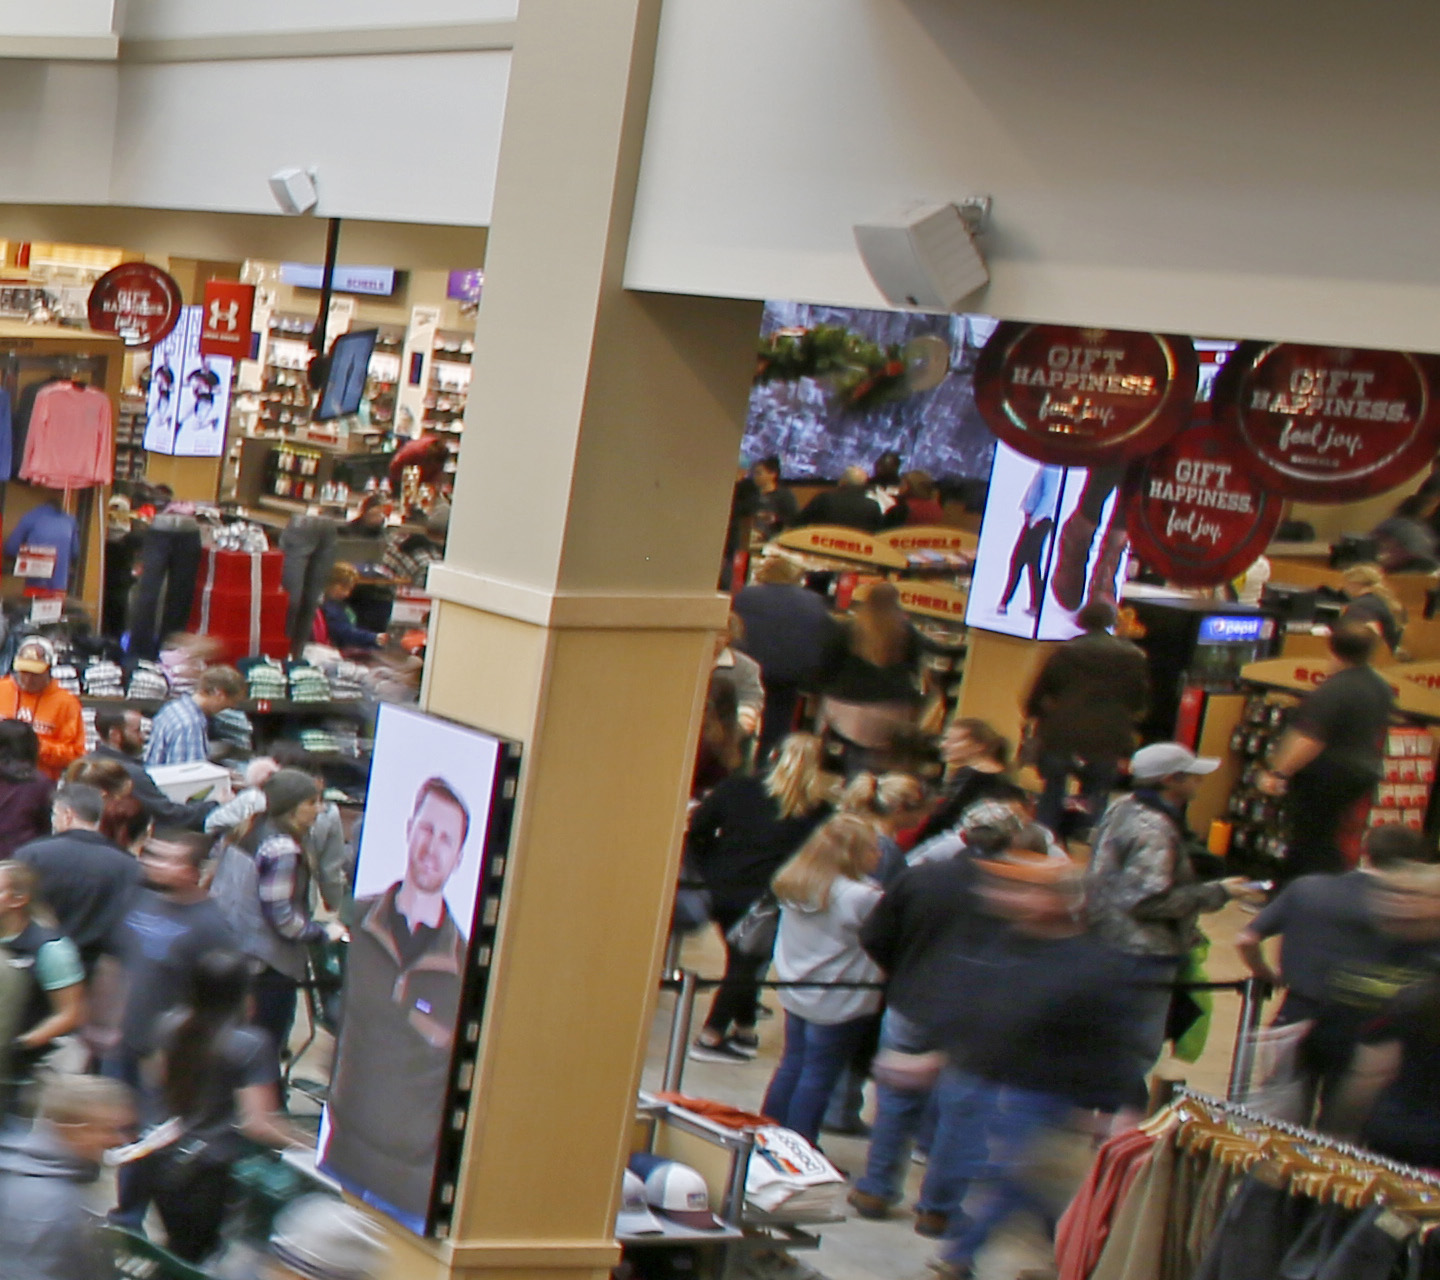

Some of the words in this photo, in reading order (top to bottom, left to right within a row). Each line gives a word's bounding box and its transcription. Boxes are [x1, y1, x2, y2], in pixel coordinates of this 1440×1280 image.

[1046, 345, 1126, 373] GIFT
[1289, 367, 1375, 399] GIFT
[1250, 388, 1411, 424] HAPPINESS.
[1279, 419, 1323, 452] feel
[1316, 423, 1364, 458] joy.
[1175, 457, 1232, 490] GIFT
[1148, 478, 1254, 514] HAPPINESS.
[1167, 506, 1195, 537] feel
[1191, 516, 1223, 545] joy.
[810, 534, 874, 556] SCHEELS
[888, 536, 962, 550] SCHEELS
[900, 591, 963, 615] CHEELS
[1225, 620, 1259, 636] pepsi
